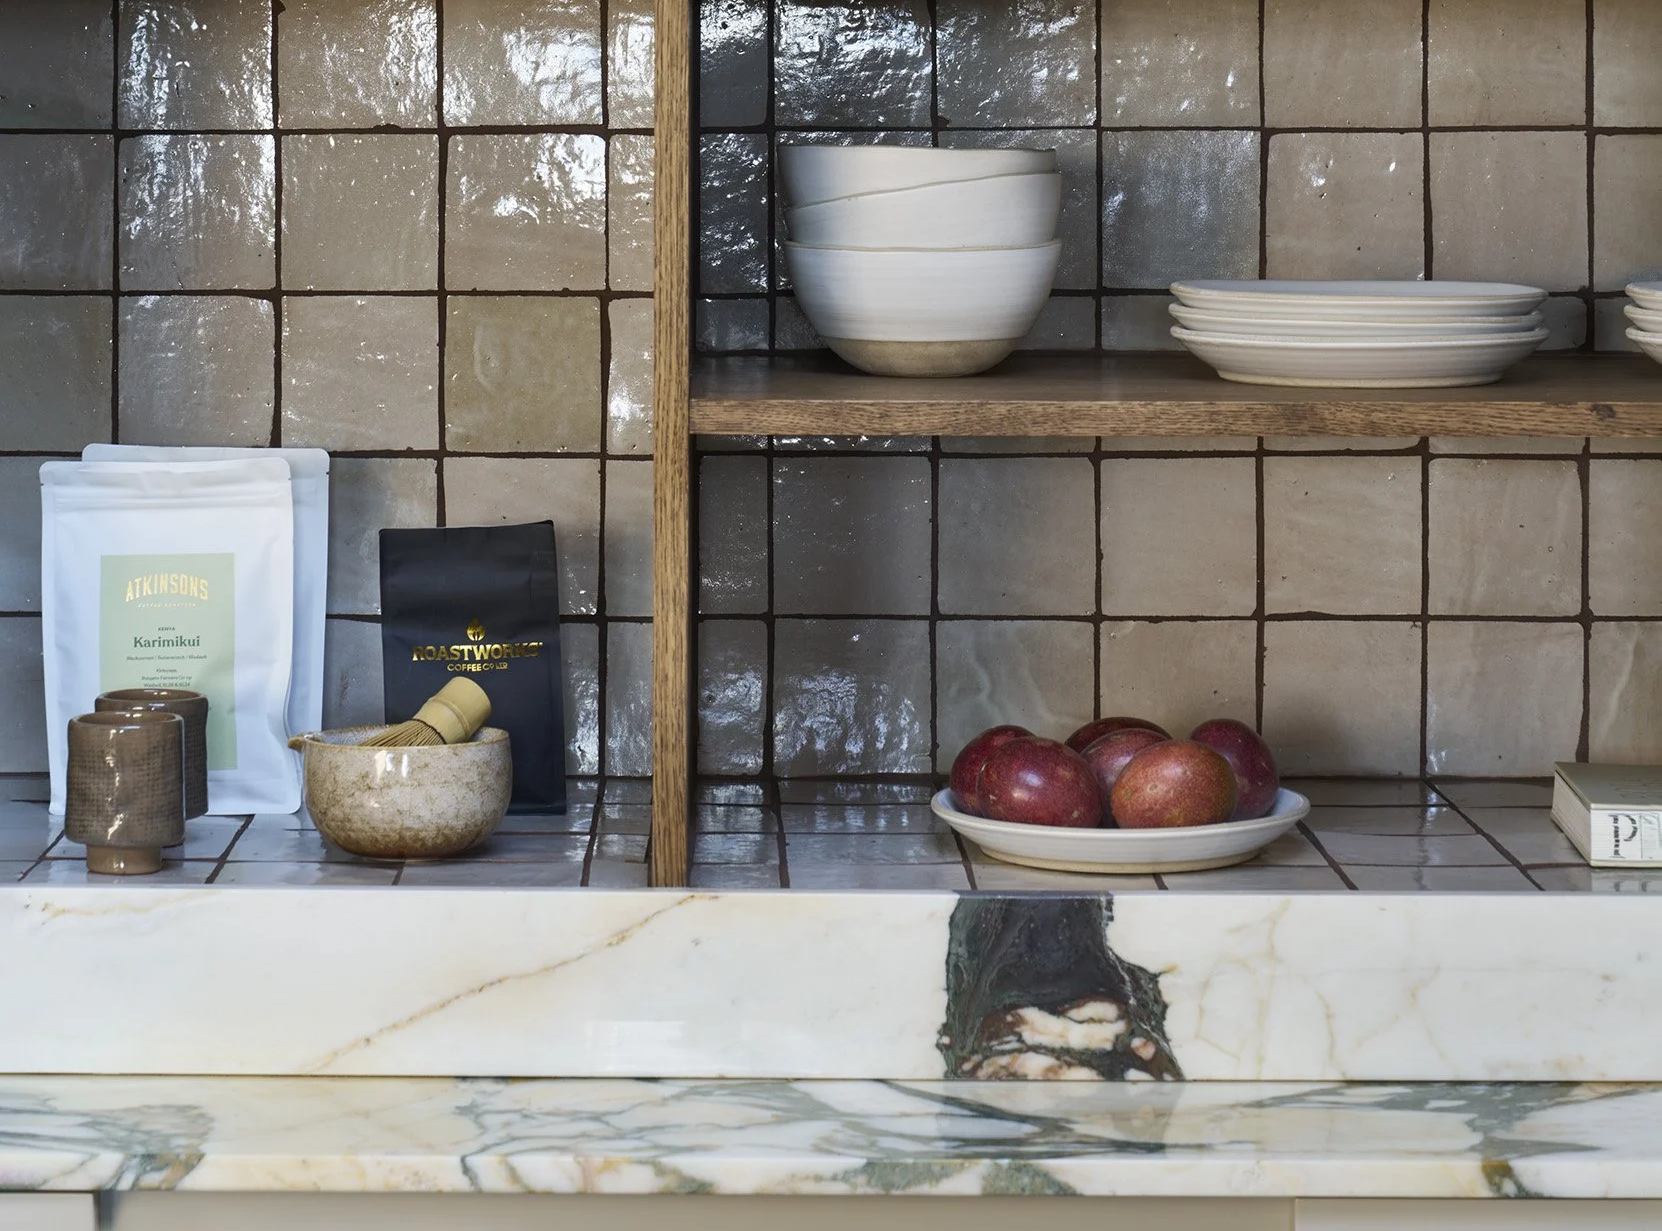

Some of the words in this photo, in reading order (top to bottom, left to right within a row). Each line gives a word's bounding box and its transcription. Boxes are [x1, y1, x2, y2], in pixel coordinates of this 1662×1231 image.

[125, 573, 209, 603] ATKINSONS
[133, 636, 201, 648] Karimikui
[412, 642, 541, 661] ROASTWORKS
[446, 663, 482, 673] COFFEE
